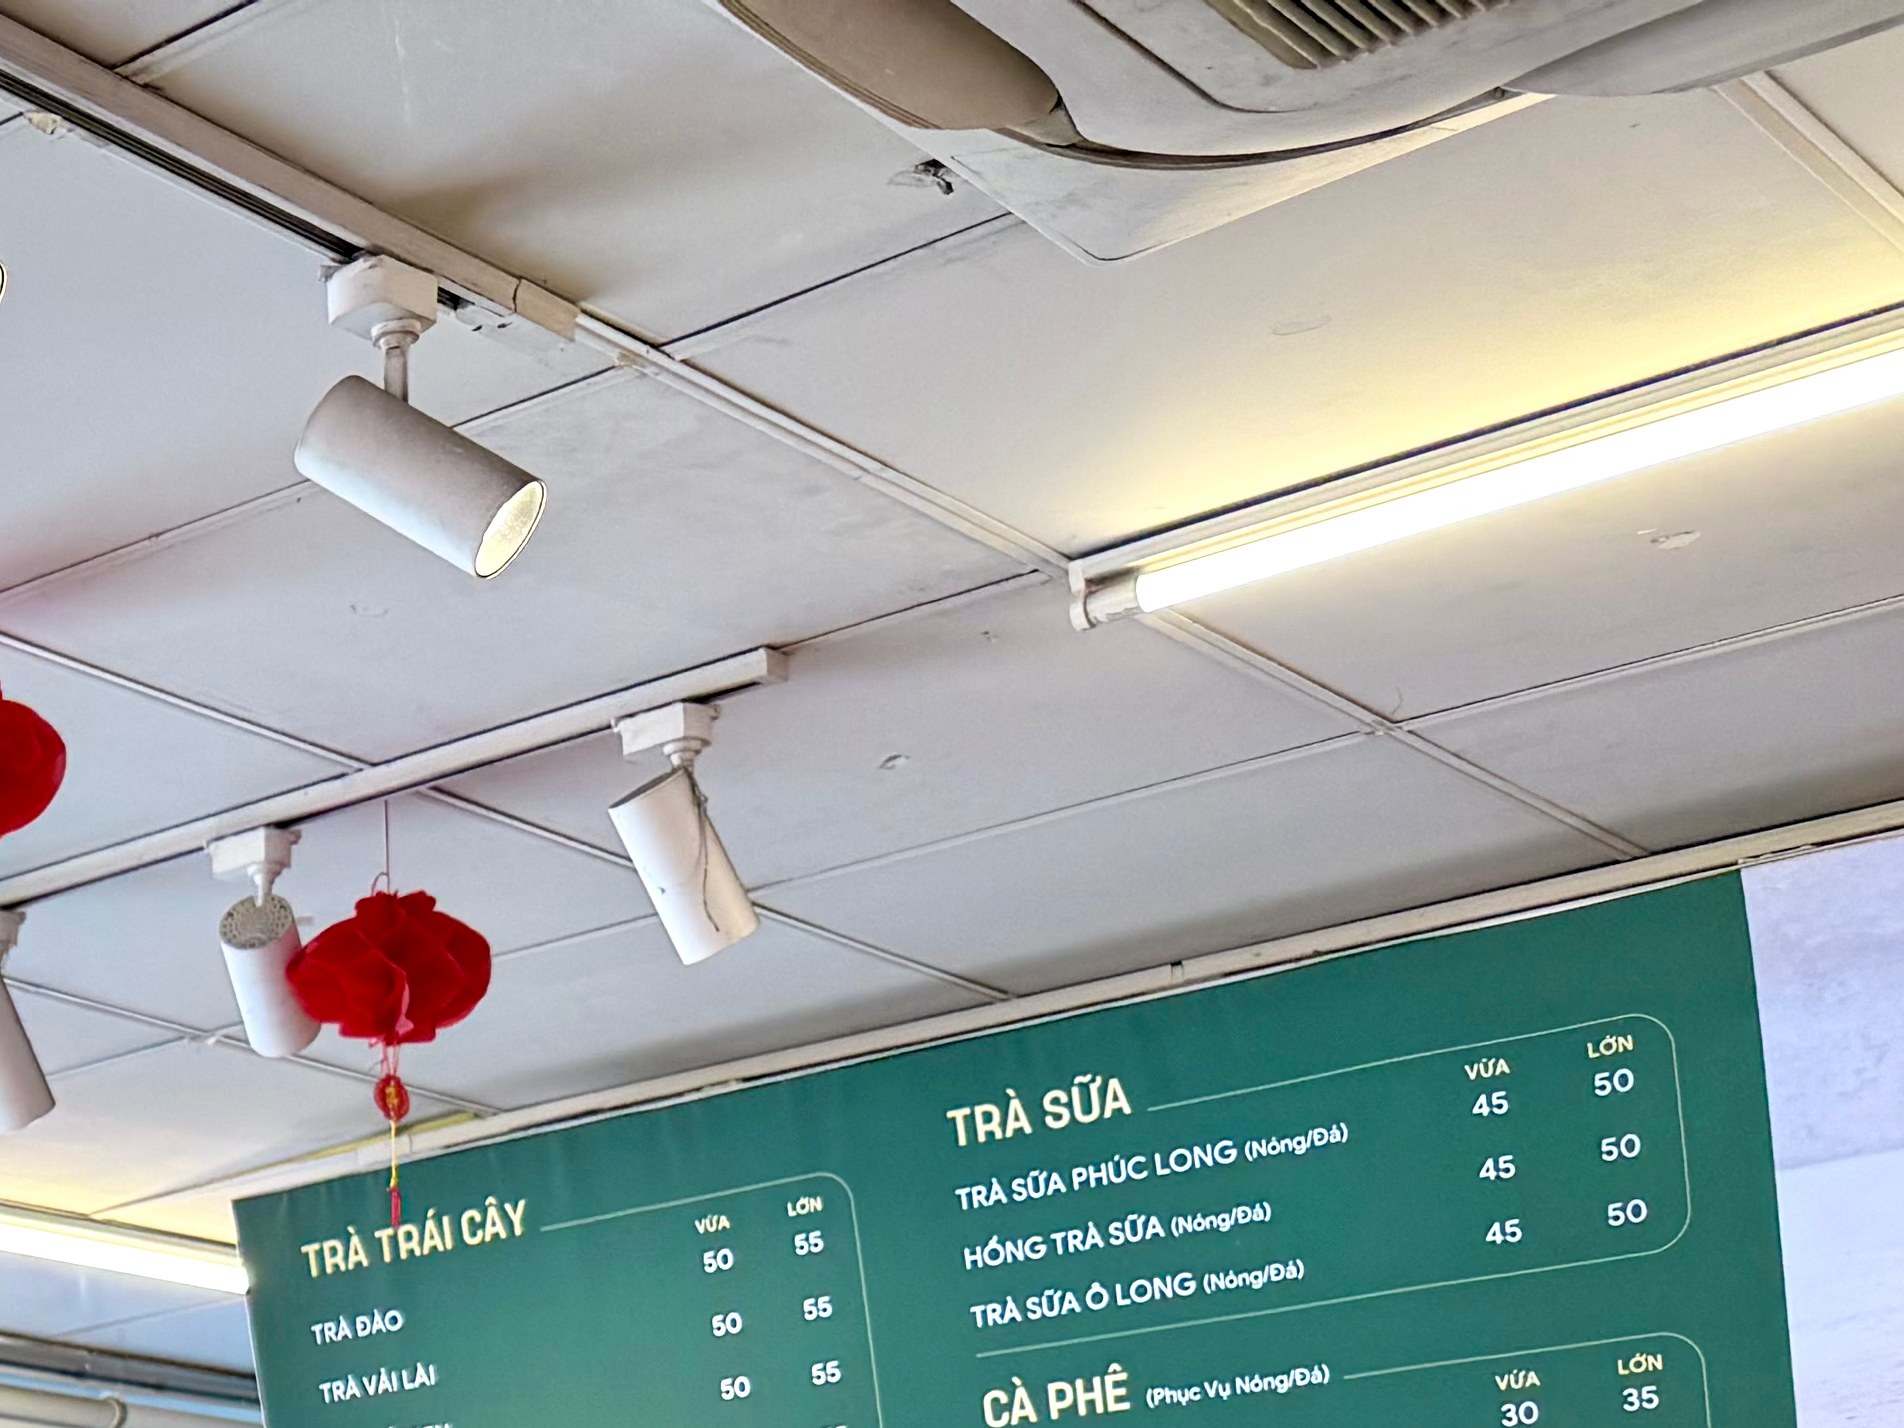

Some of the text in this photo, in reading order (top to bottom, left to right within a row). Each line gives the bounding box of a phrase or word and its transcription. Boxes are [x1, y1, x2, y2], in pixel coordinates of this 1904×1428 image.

[1594, 1068, 1635, 1097] 50
[946, 1073, 1132, 1147] TRÀ SỮA
[1472, 1090, 1509, 1117] 45
[1601, 1133, 1641, 1162] 50
[954, 1177, 1008, 1211] TRÀ
[1011, 1169, 1067, 1202] SỮA
[1071, 1154, 1149, 1191] PHÚC
[1154, 1139, 1238, 1176] LONG
[1479, 1154, 1516, 1181] 45
[1607, 1198, 1648, 1227] 50
[300, 1196, 526, 1278] TRÀ TRÁI CÂY
[794, 1230, 824, 1256] 55
[1049, 1221, 1105, 1255] TRÀ
[1108, 1213, 1166, 1246] SỮA
[1485, 1218, 1523, 1245] 45
[703, 1248, 734, 1273] 50
[803, 1295, 833, 1321] 55
[969, 1295, 1023, 1329] TRÀ
[1025, 1288, 1082, 1320] SỮA
[1085, 1281, 1110, 1311] Ô
[1115, 1271, 1197, 1306] LONG
[310, 1308, 404, 1345] TRÀ ĐÀO
[711, 1311, 743, 1337] 50
[811, 1360, 842, 1386] 55
[318, 1374, 361, 1404] TRÀ
[720, 1375, 751, 1401] 50
[983, 1376, 1039, 1428] CÀ
[1047, 1362, 1131, 1421] PHÊ
[1203, 1380, 1232, 1401] Vụ
[1622, 1385, 1660, 1412] 35
[1500, 1400, 1539, 1427] 30
